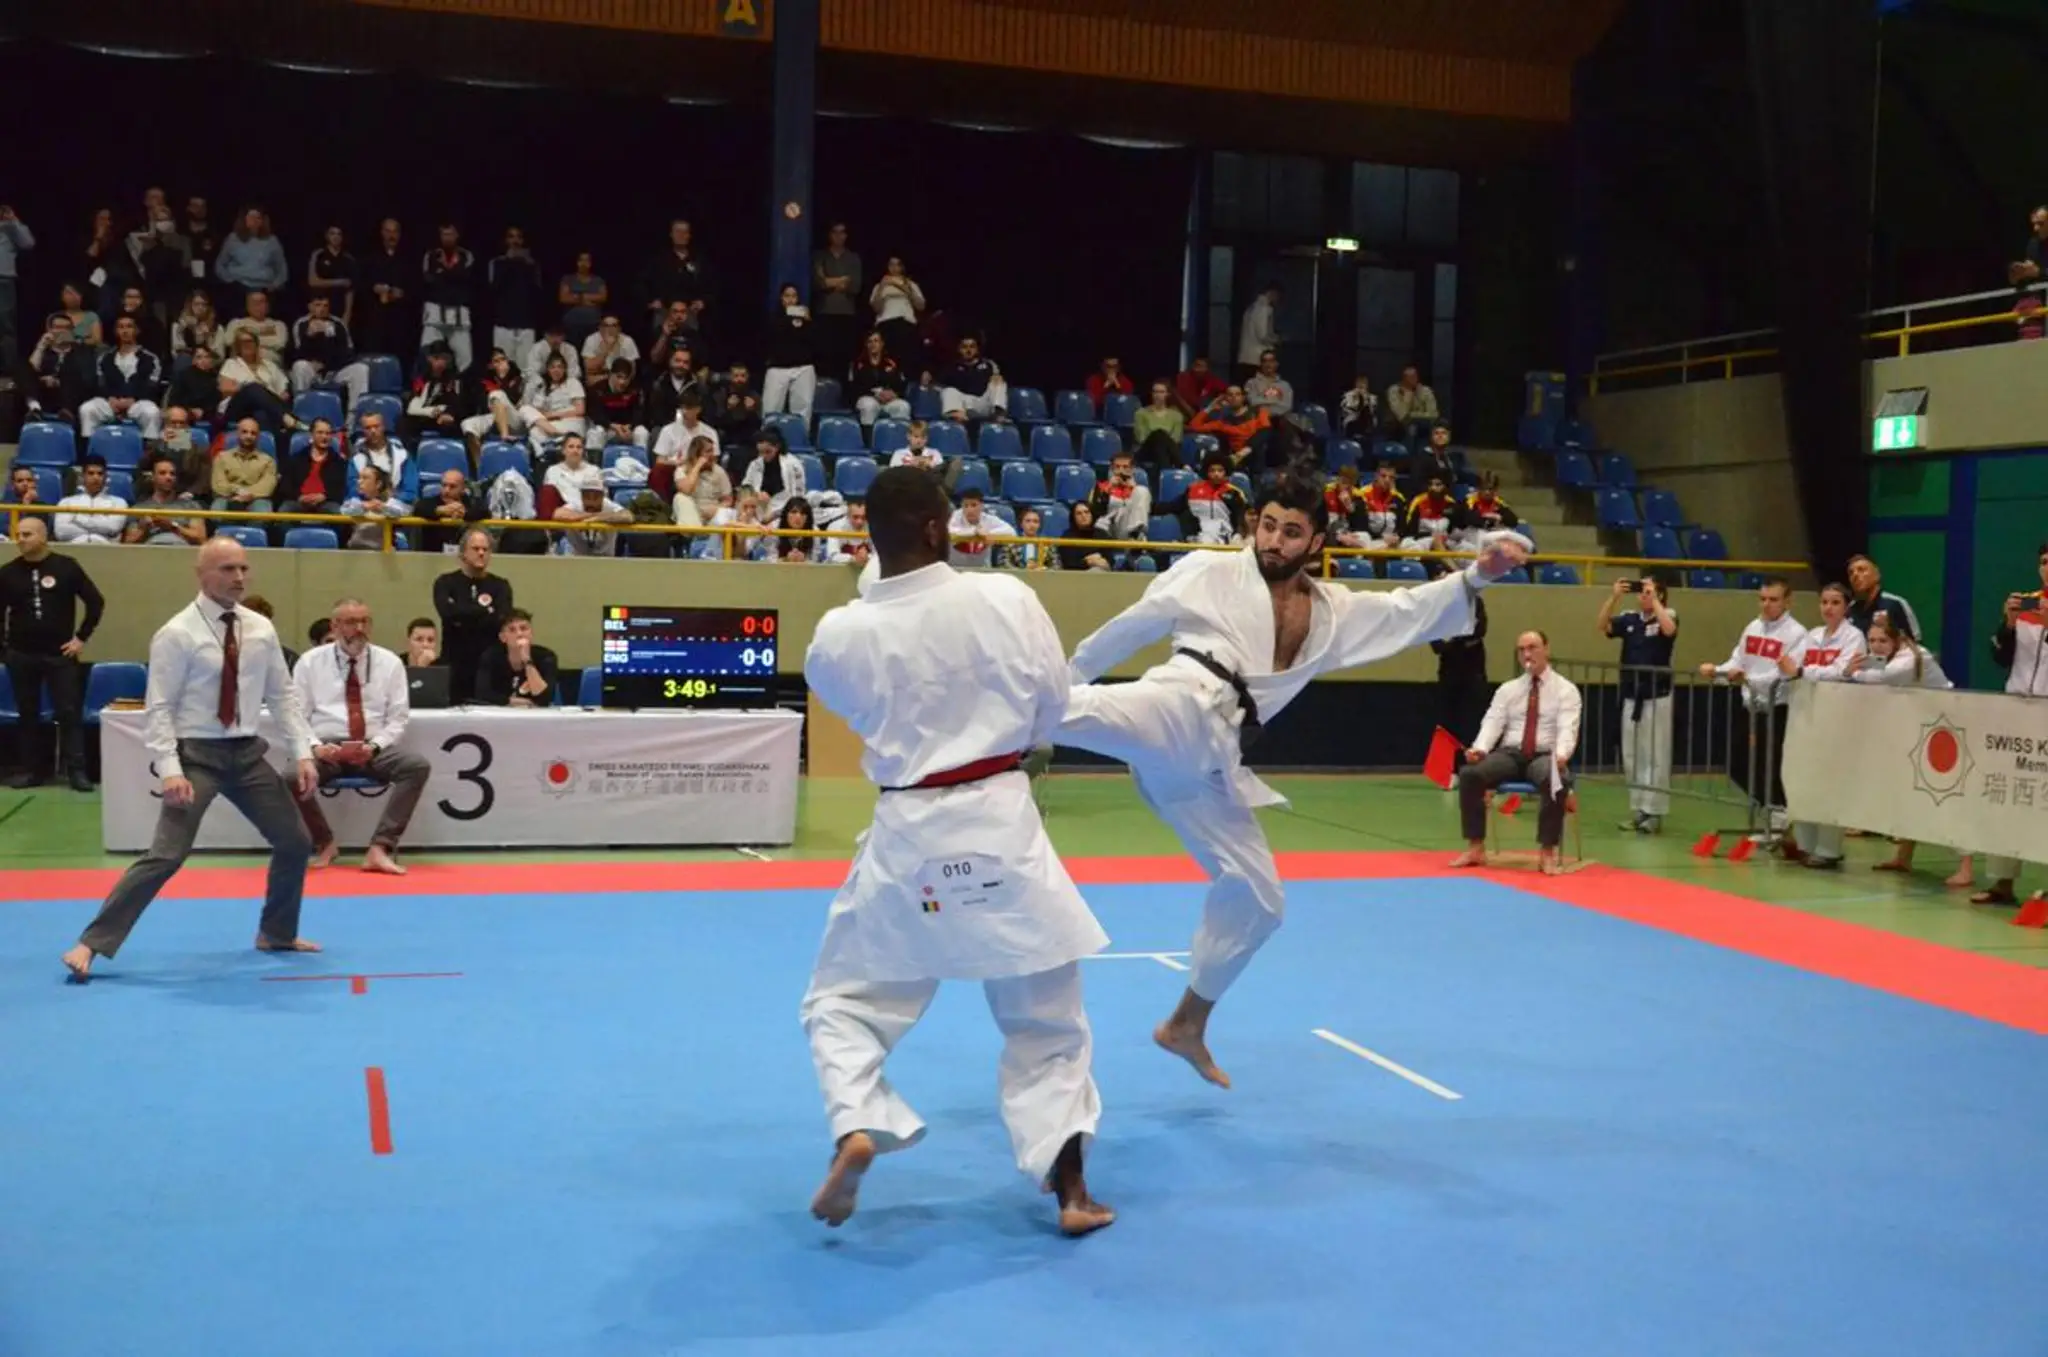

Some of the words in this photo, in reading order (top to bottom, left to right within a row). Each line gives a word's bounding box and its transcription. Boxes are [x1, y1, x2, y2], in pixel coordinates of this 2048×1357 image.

[724, 0, 756, 25] A
[604, 620, 628, 630] BEL
[603, 653, 629, 663] ENG
[1985, 733, 2034, 754] SWISS
[437, 733, 495, 821] 3
[943, 861, 972, 877] 010
